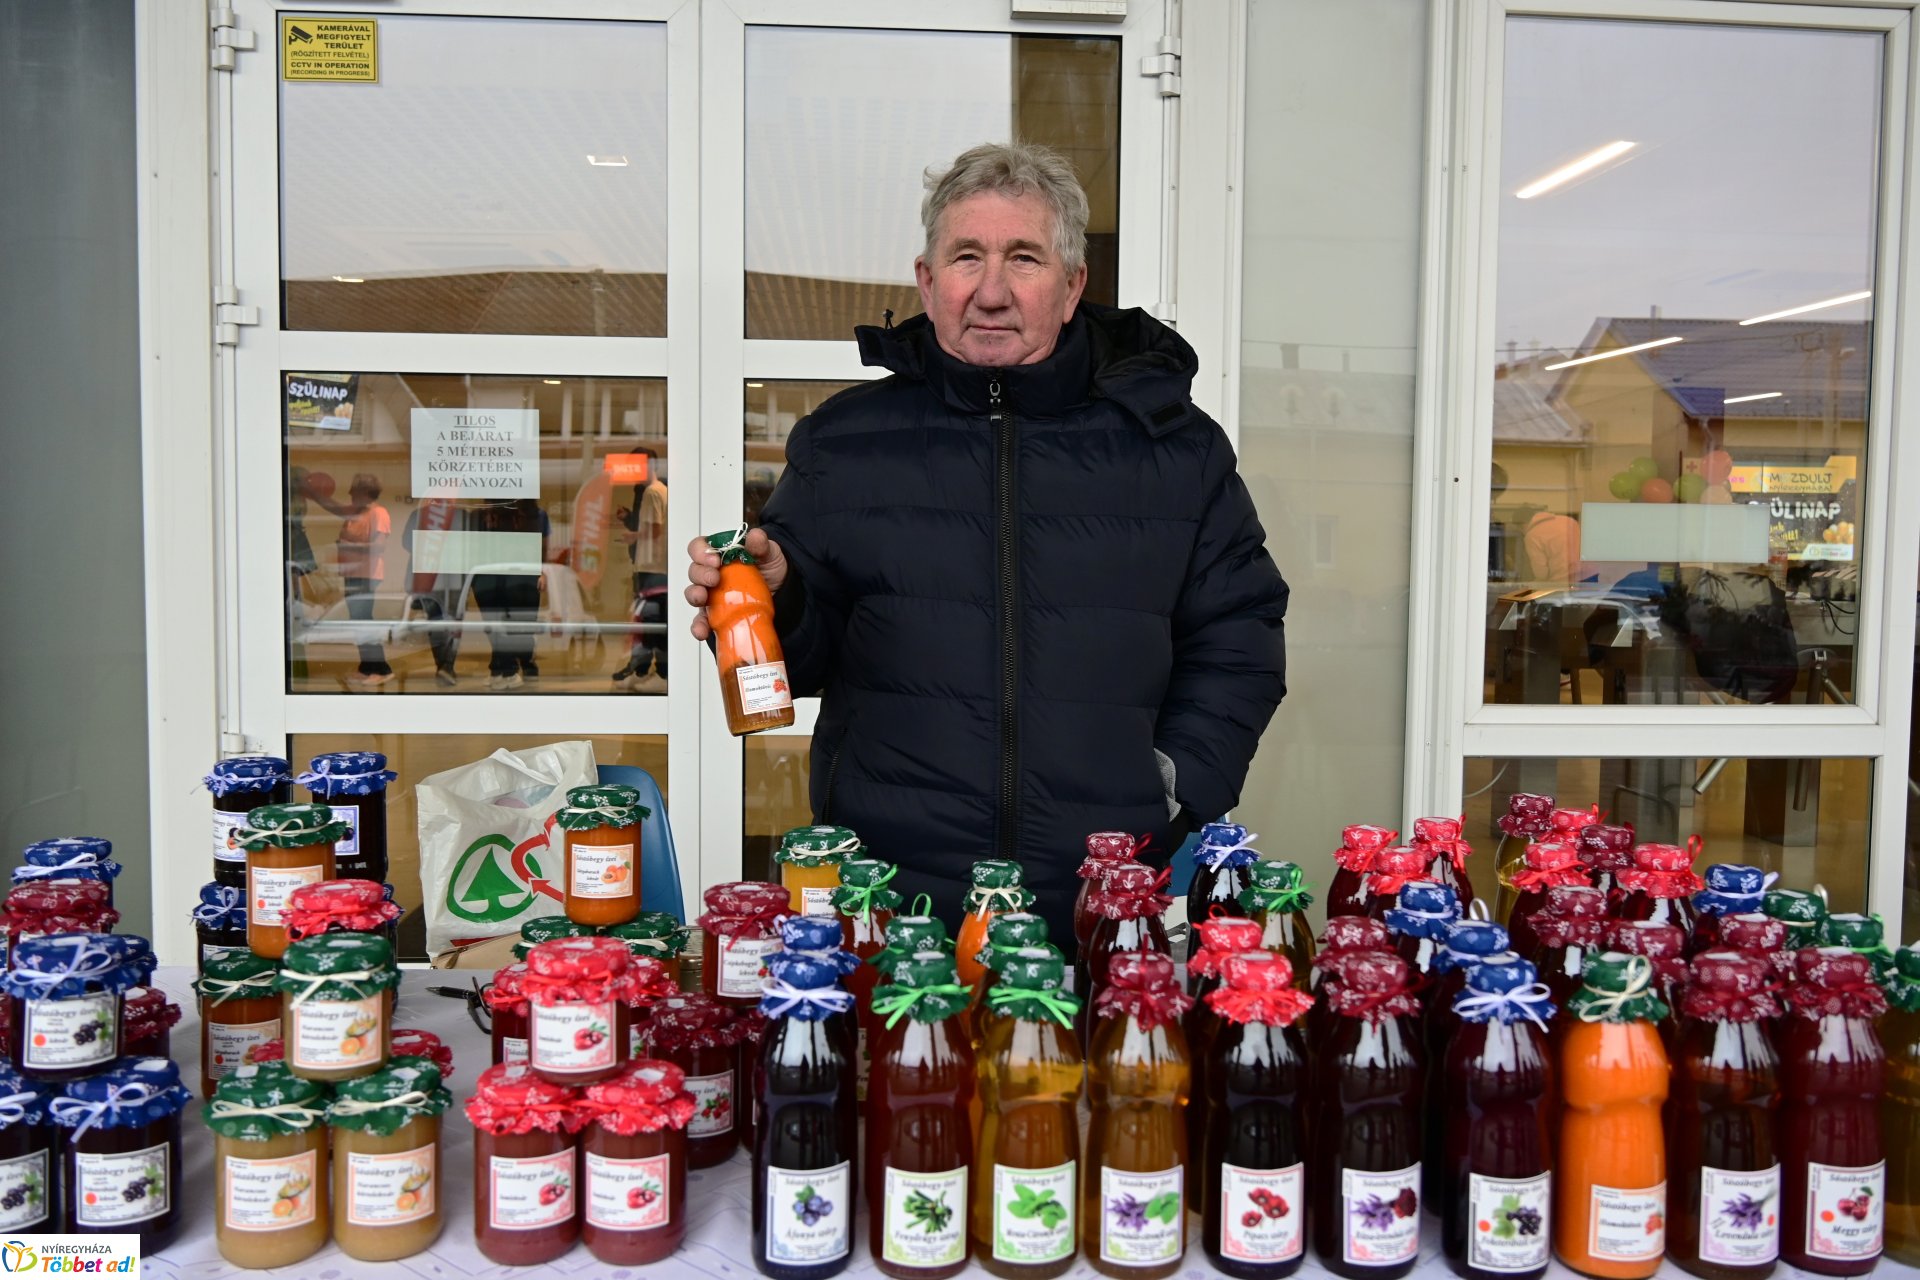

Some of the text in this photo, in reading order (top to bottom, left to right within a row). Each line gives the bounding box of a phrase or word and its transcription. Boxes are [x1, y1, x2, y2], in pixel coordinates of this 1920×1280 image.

[318, 24, 370, 32] KAMERÁVAL
[289, 381, 348, 401] SZÜLINAP
[454, 416, 496, 426] TILOS
[437, 429, 513, 441] A BEJÁRAT
[437, 444, 514, 456] 5 MÉTERES
[428, 460, 523, 472] KÖRZETÉBEN
[428, 474, 523, 488] DOHÁNYOZNI
[1749, 497, 1840, 520] ÜLINAP
